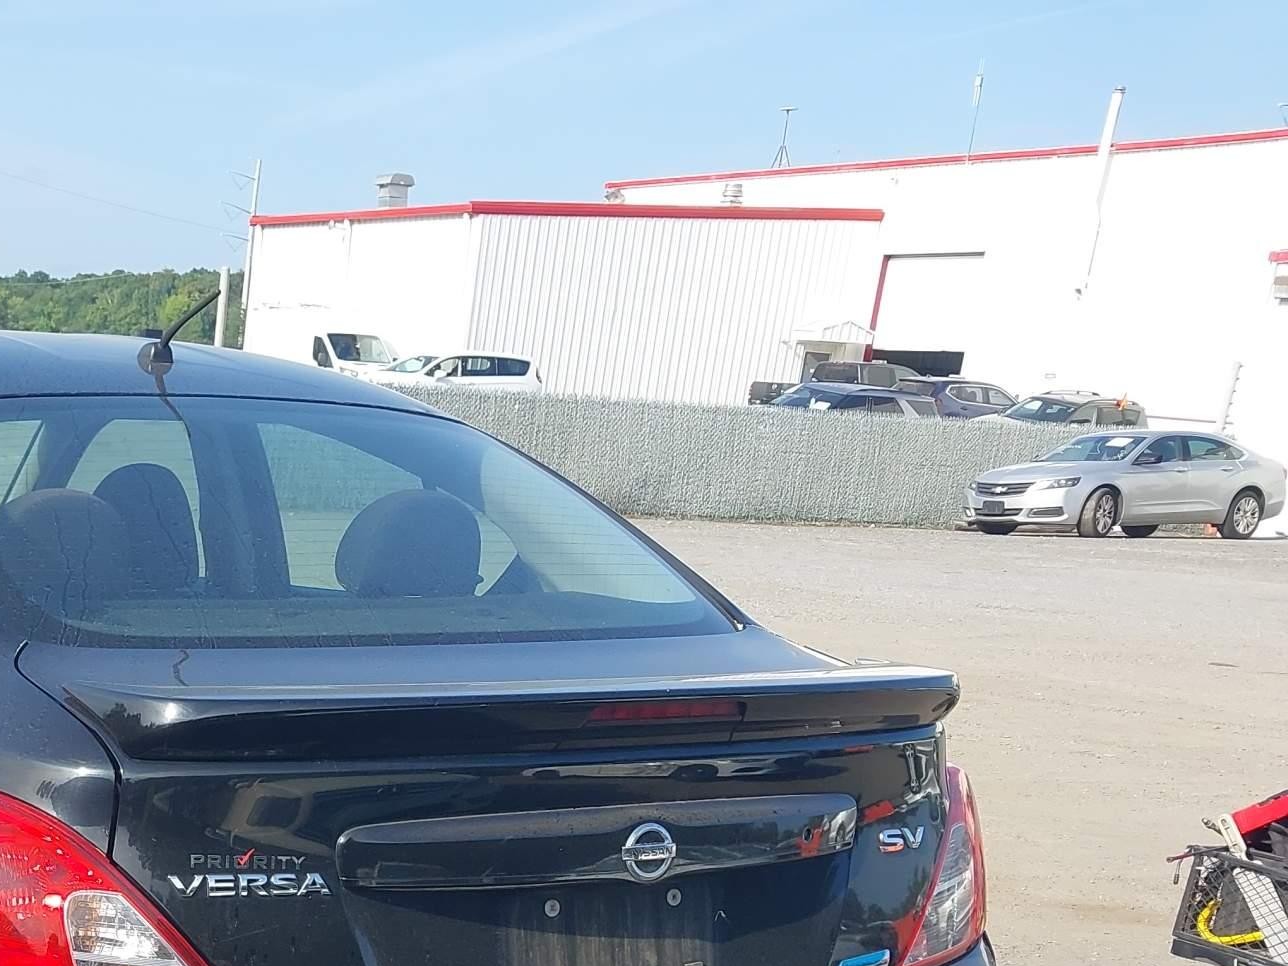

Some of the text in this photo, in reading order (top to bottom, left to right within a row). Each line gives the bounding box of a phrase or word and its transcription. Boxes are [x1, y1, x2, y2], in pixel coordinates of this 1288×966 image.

[879, 826, 925, 853] SV
[190, 852, 307, 870] PRIORITY
[167, 872, 333, 898] VERSA
